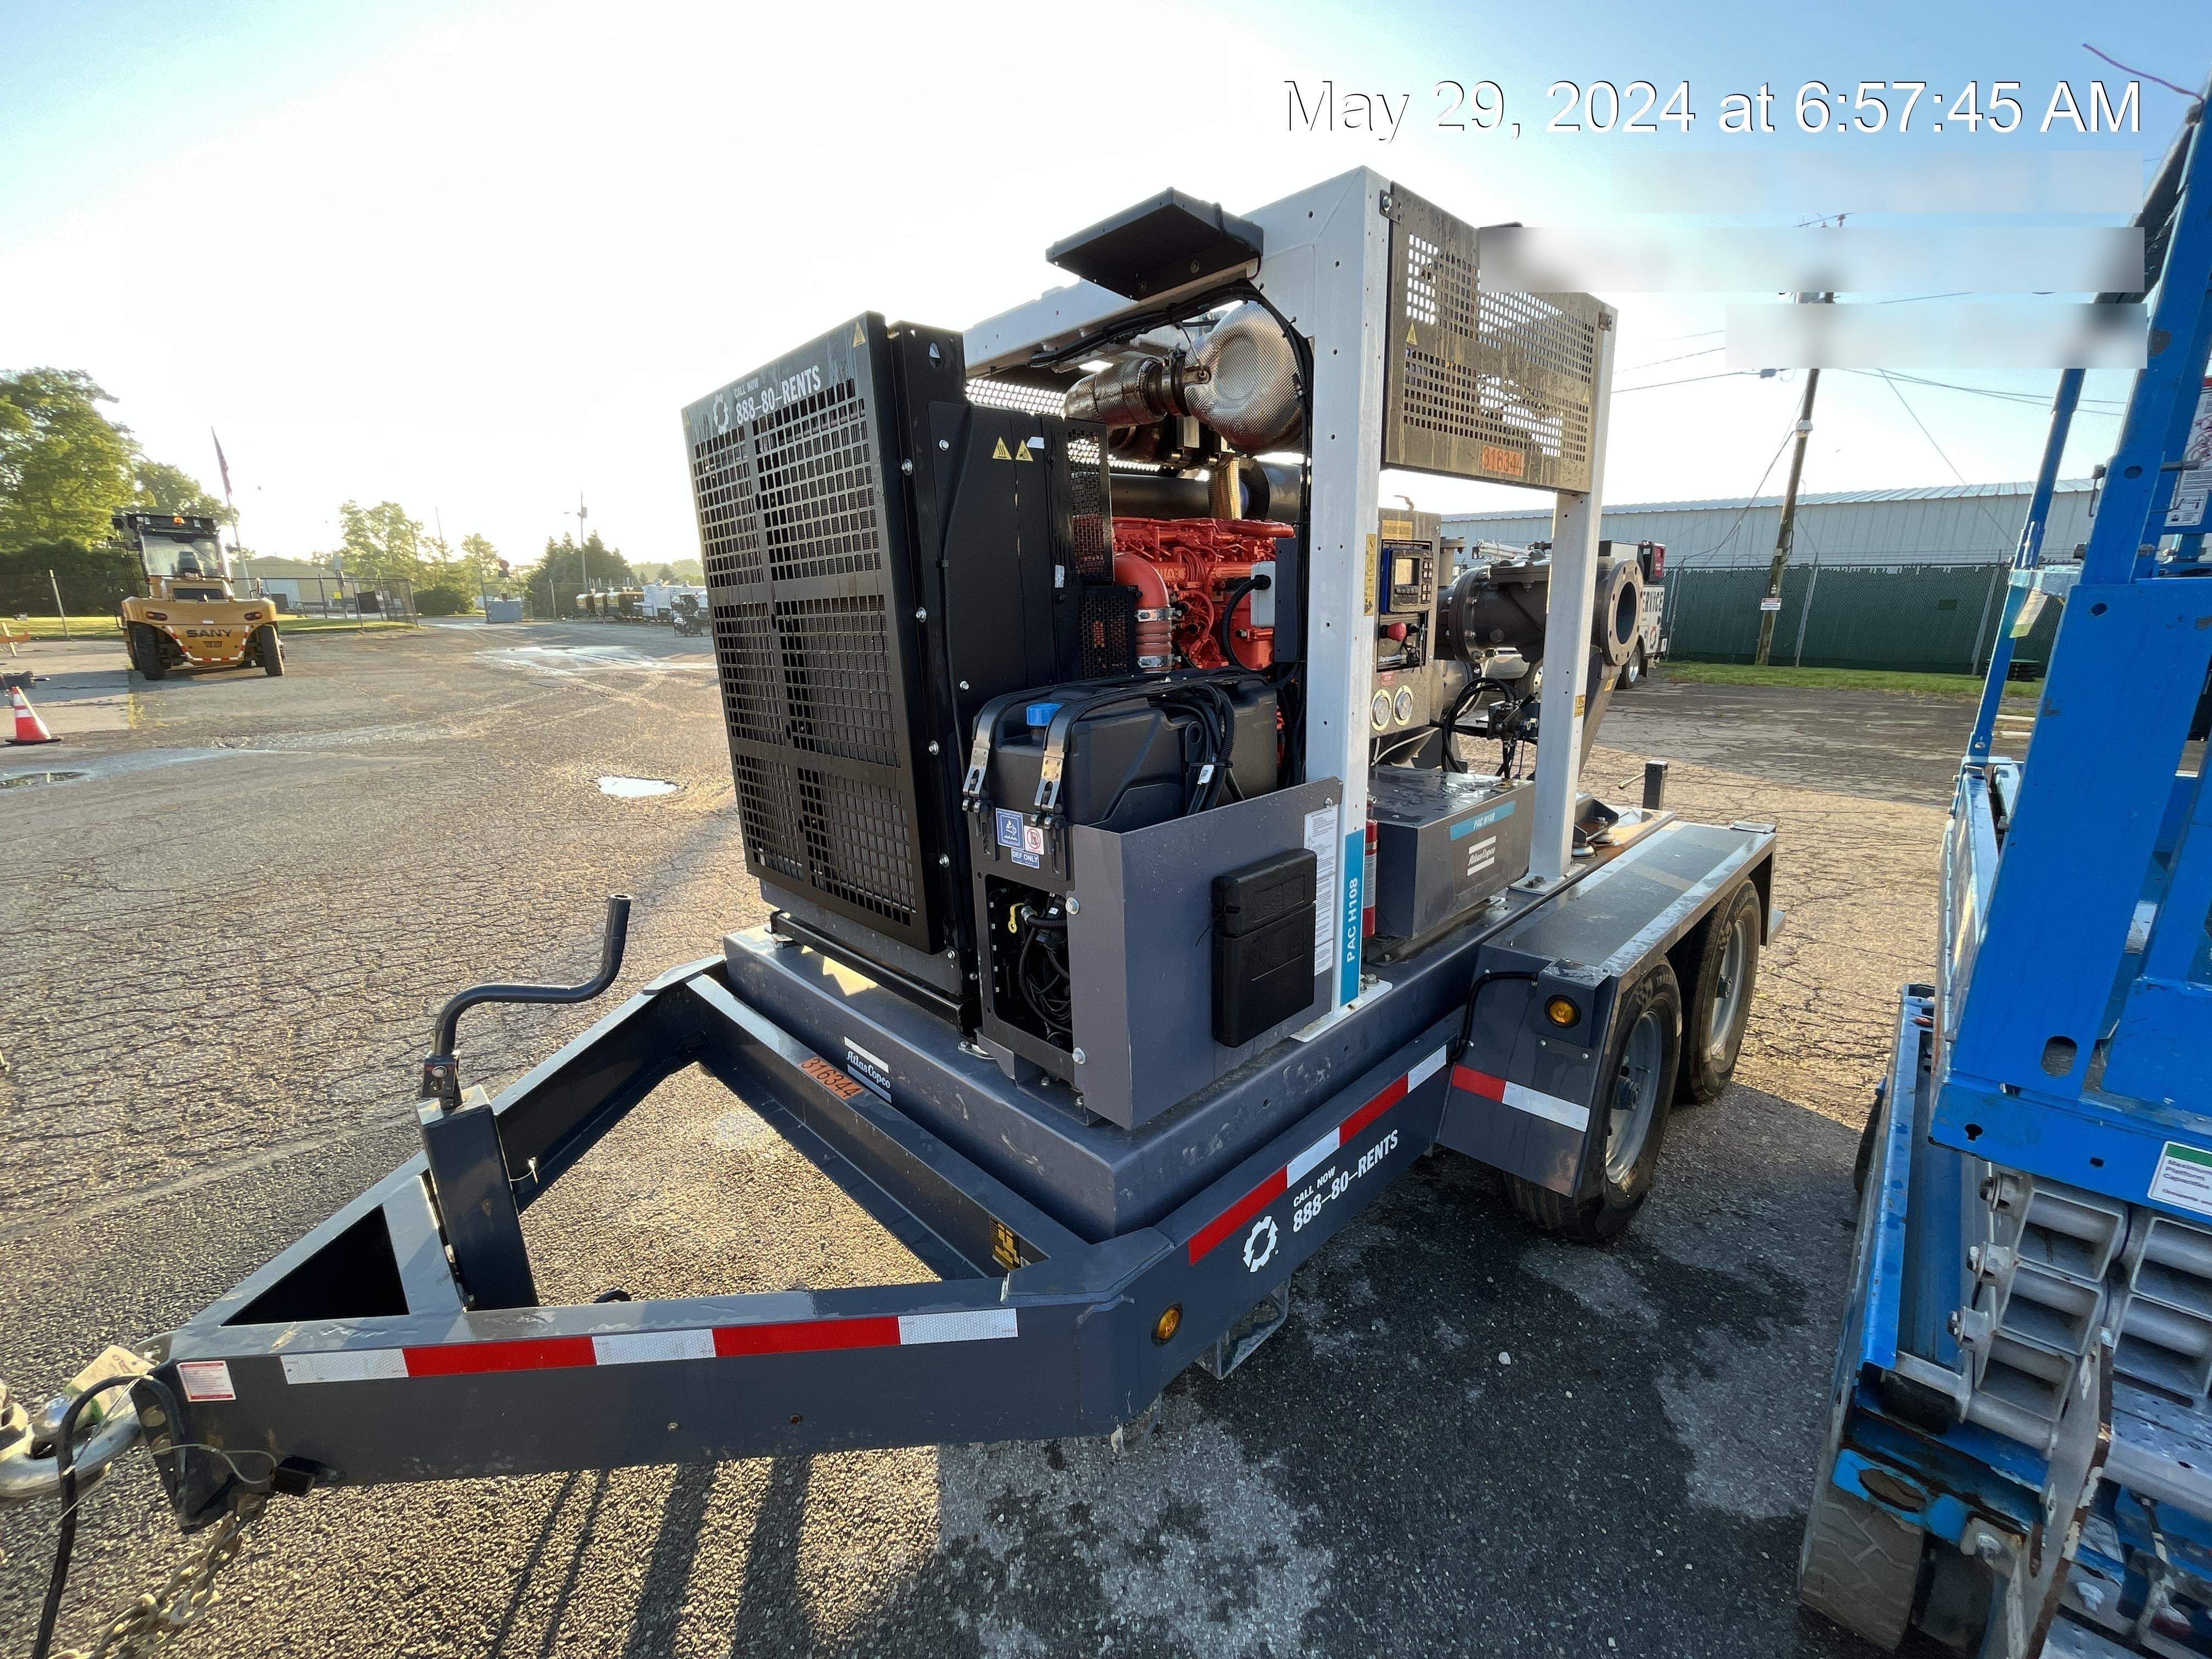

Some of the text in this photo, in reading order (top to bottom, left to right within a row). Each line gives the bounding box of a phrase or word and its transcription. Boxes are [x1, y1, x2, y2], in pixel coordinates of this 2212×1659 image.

[735, 377, 759, 398] CALL NOW
[736, 365, 821, 425] 888-80-RENTS
[1483, 446, 1523, 475] 316344
[187, 629, 233, 637] SANY
[1473, 812, 1496, 830] PAC H108
[1012, 851, 1023, 859] DEF
[1023, 854, 1038, 863] ONLY
[1346, 877, 1358, 963] PAC H108
[801, 1058, 862, 1098] 316344
[1293, 1129, 1398, 1233] 888-80-RENTS
[1293, 1166, 1336, 1207] CALL NOW
